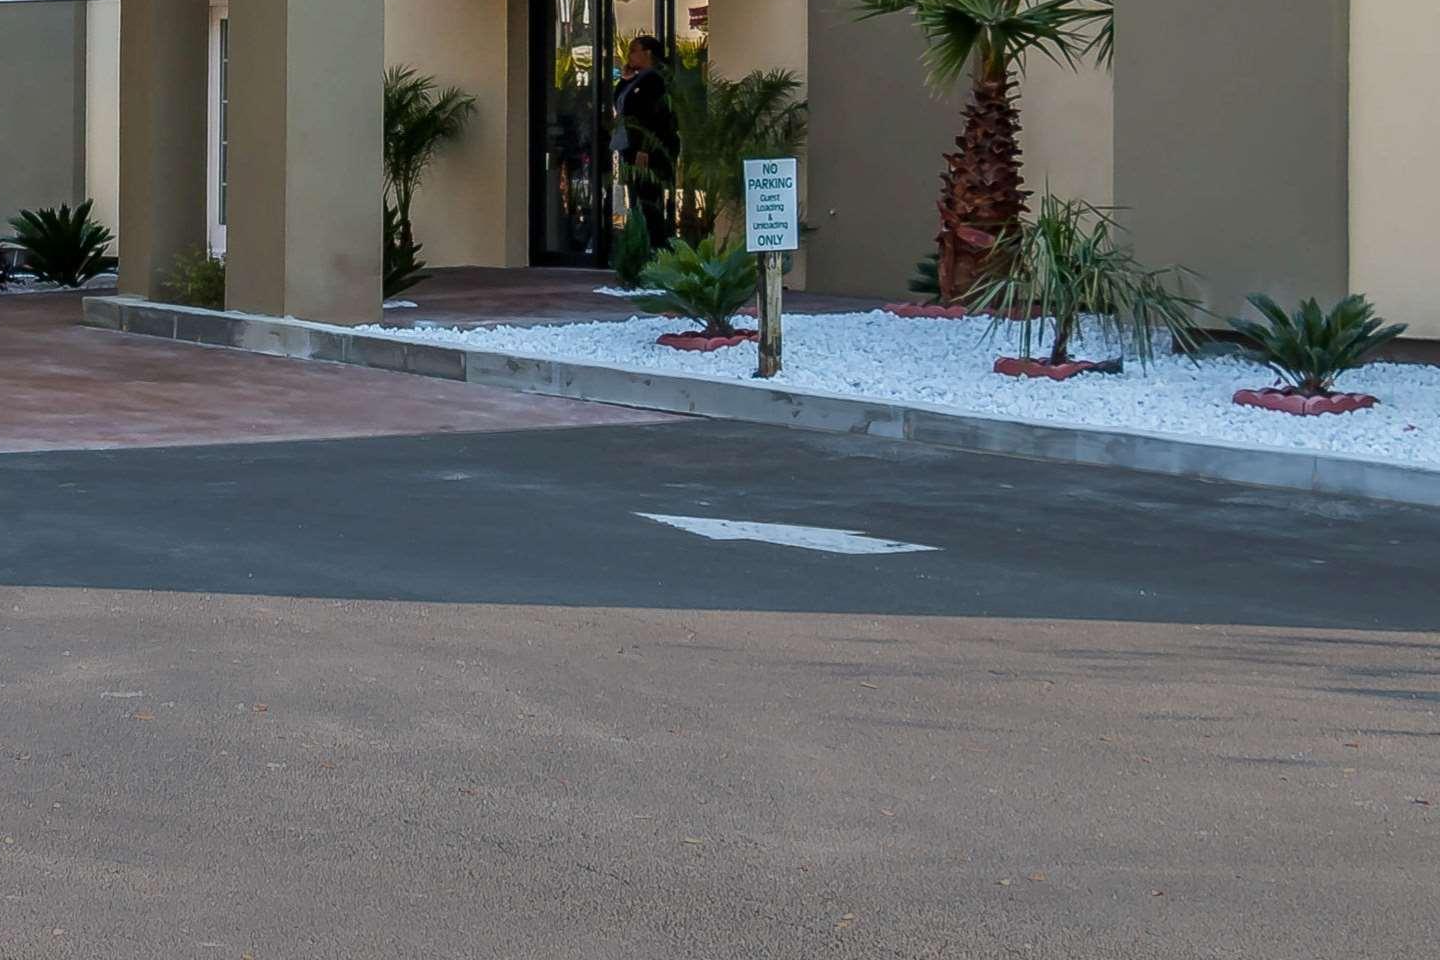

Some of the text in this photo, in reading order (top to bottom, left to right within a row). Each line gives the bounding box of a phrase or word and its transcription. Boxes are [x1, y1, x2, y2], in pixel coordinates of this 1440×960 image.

[762, 163, 778, 175] NO
[748, 177, 793, 190] PARKING
[756, 203, 785, 213] Loading
[757, 234, 784, 246] ONLY
